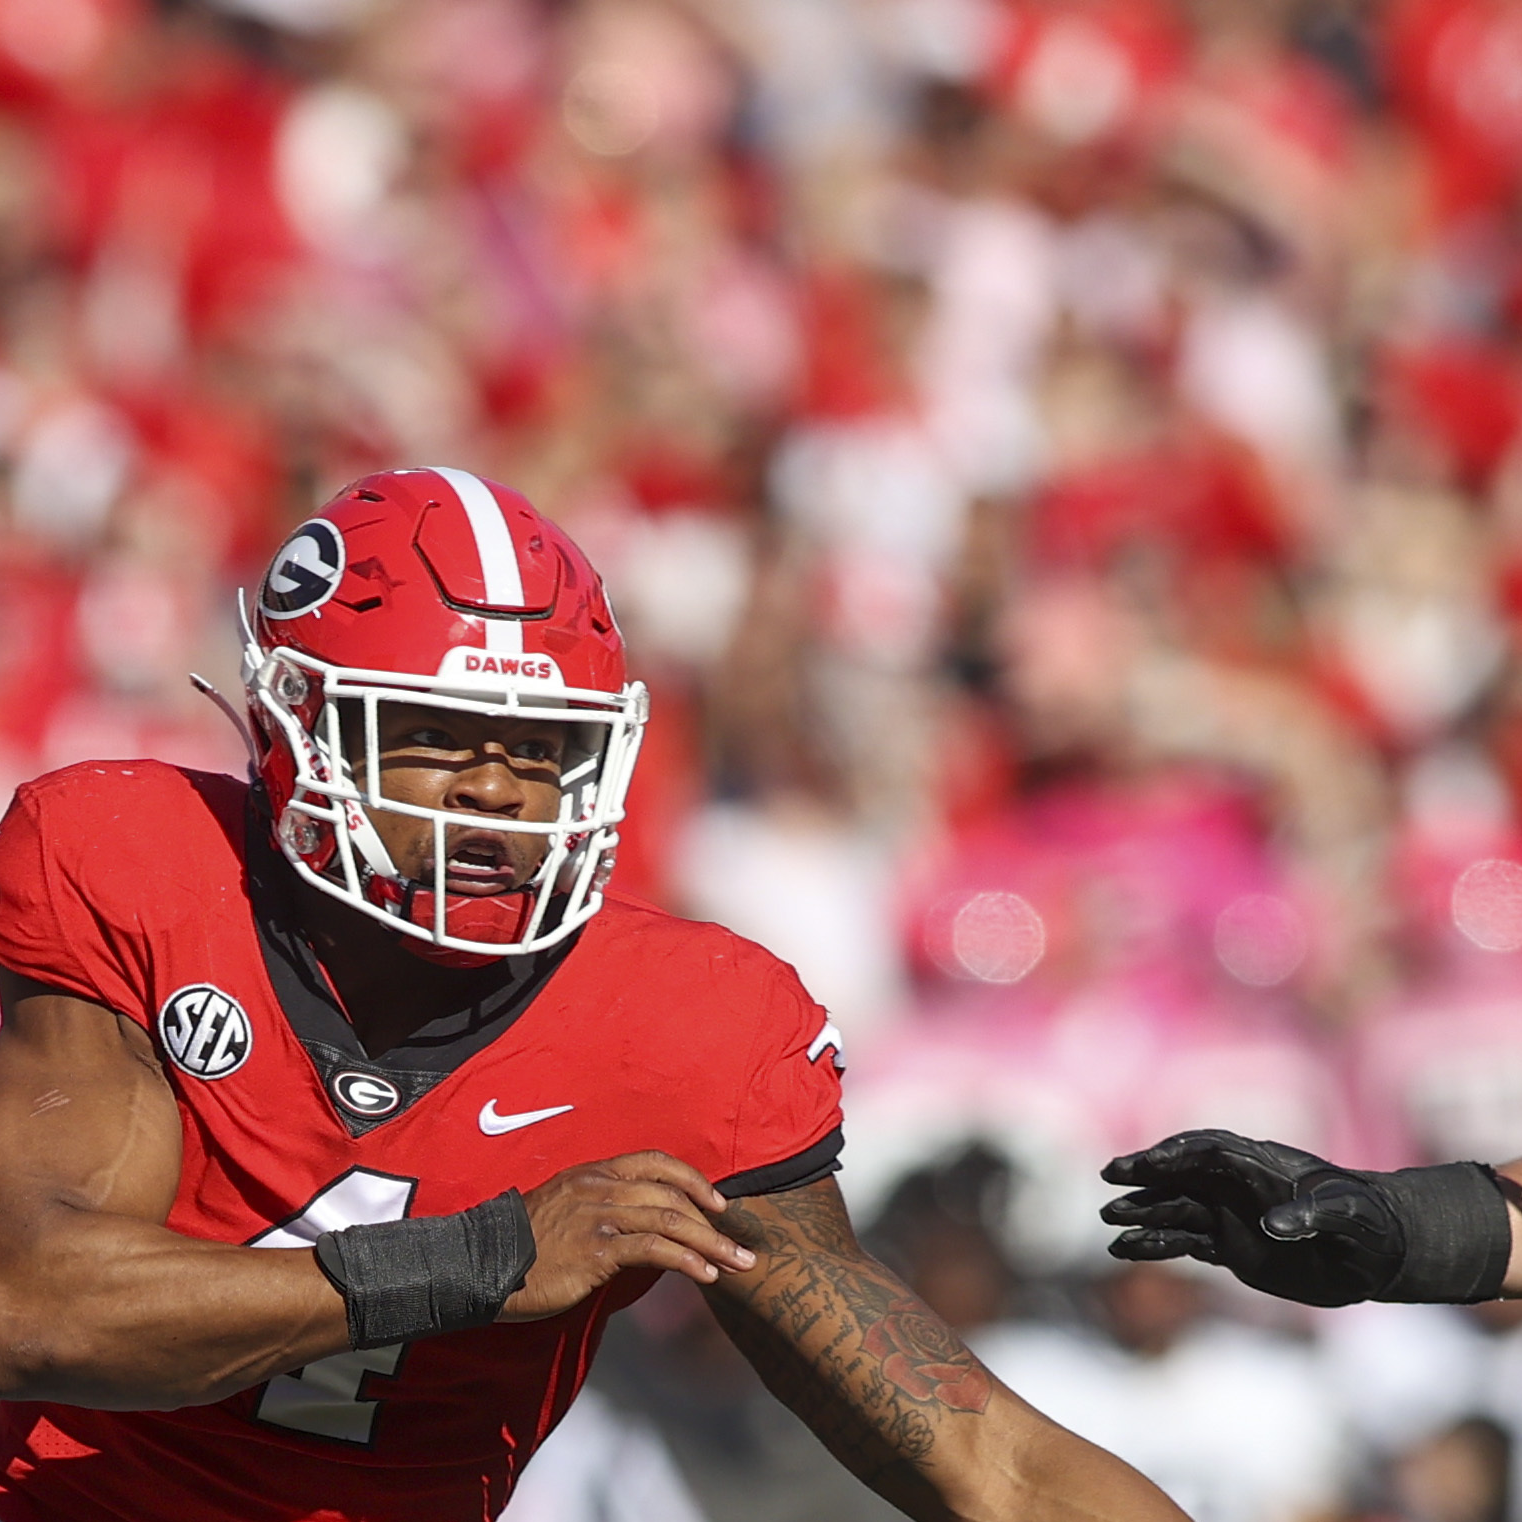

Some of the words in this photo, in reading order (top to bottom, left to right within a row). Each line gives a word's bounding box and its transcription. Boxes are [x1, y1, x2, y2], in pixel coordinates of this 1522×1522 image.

[258, 518, 346, 620] G
[465, 655, 552, 679] DAWGS
[166, 990, 246, 1073] SEC
[334, 1073, 398, 1114] G
